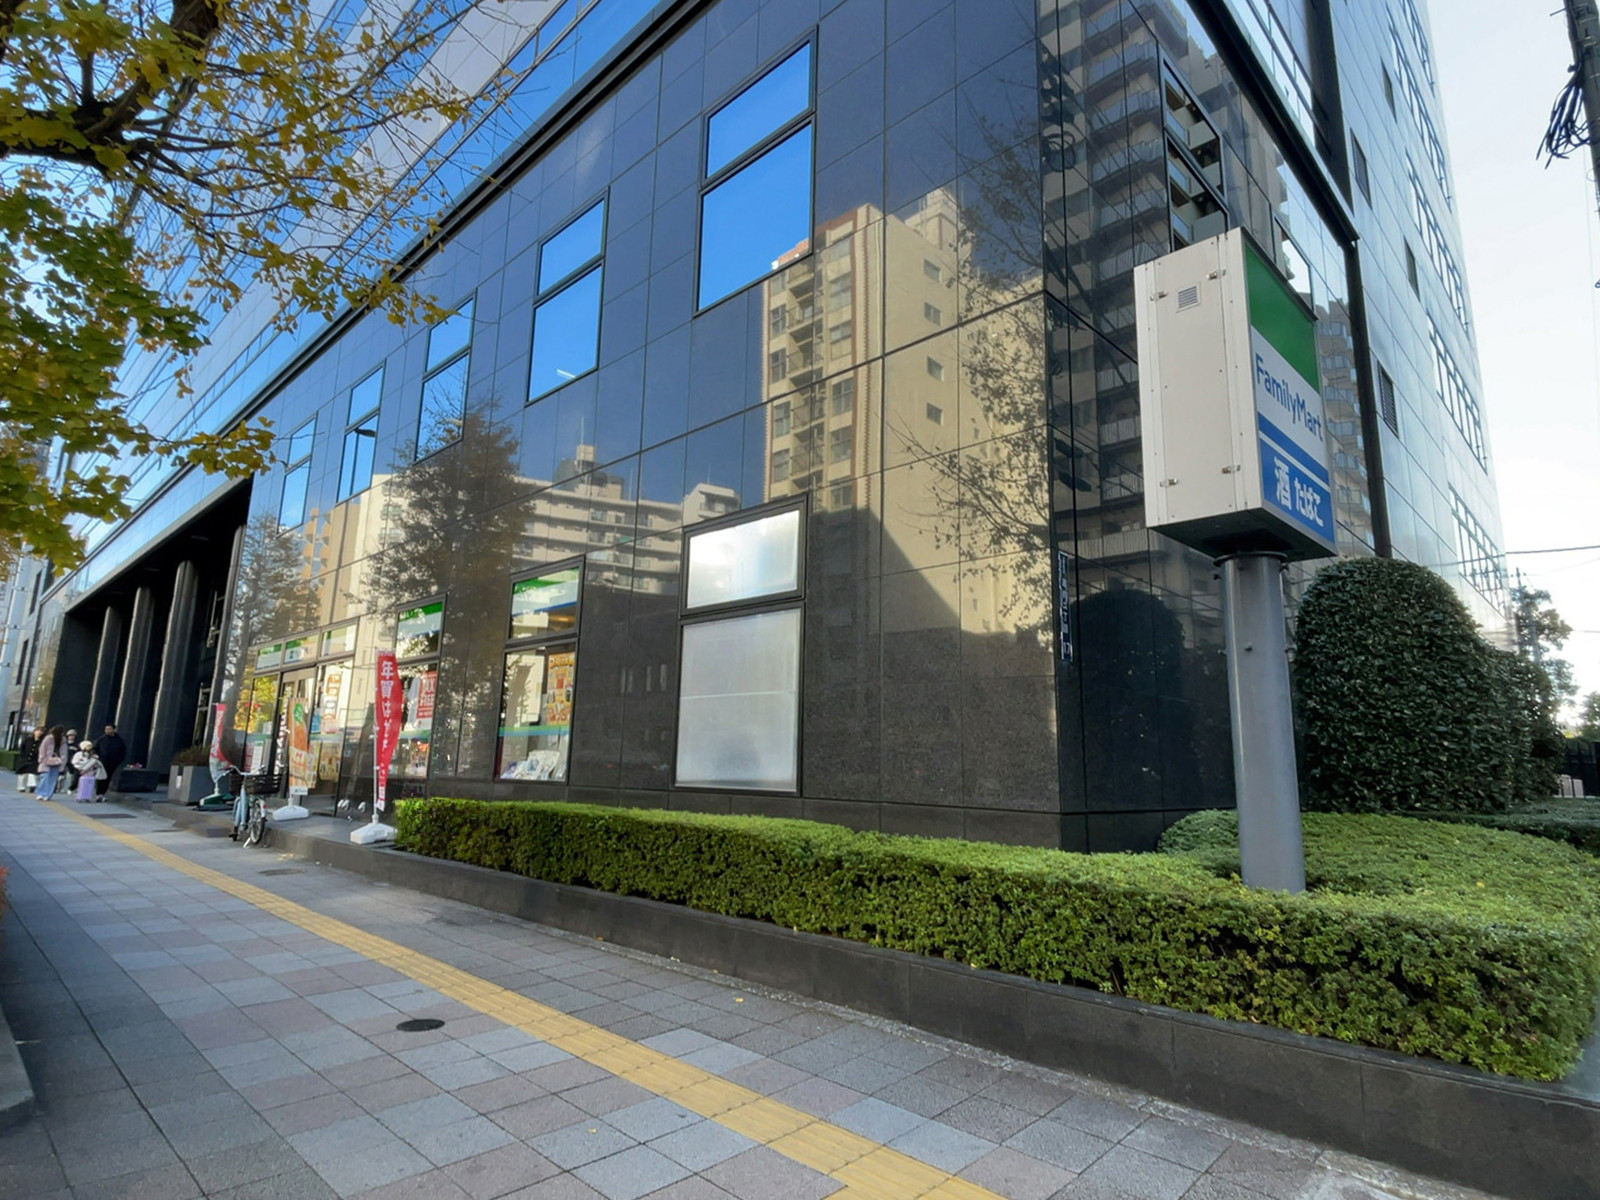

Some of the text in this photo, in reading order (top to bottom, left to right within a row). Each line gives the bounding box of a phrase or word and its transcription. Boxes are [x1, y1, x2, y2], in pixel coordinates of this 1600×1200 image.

[1255, 353, 1323, 442] FamilyMart
[1274, 456, 1323, 527] 酒 たばこ
